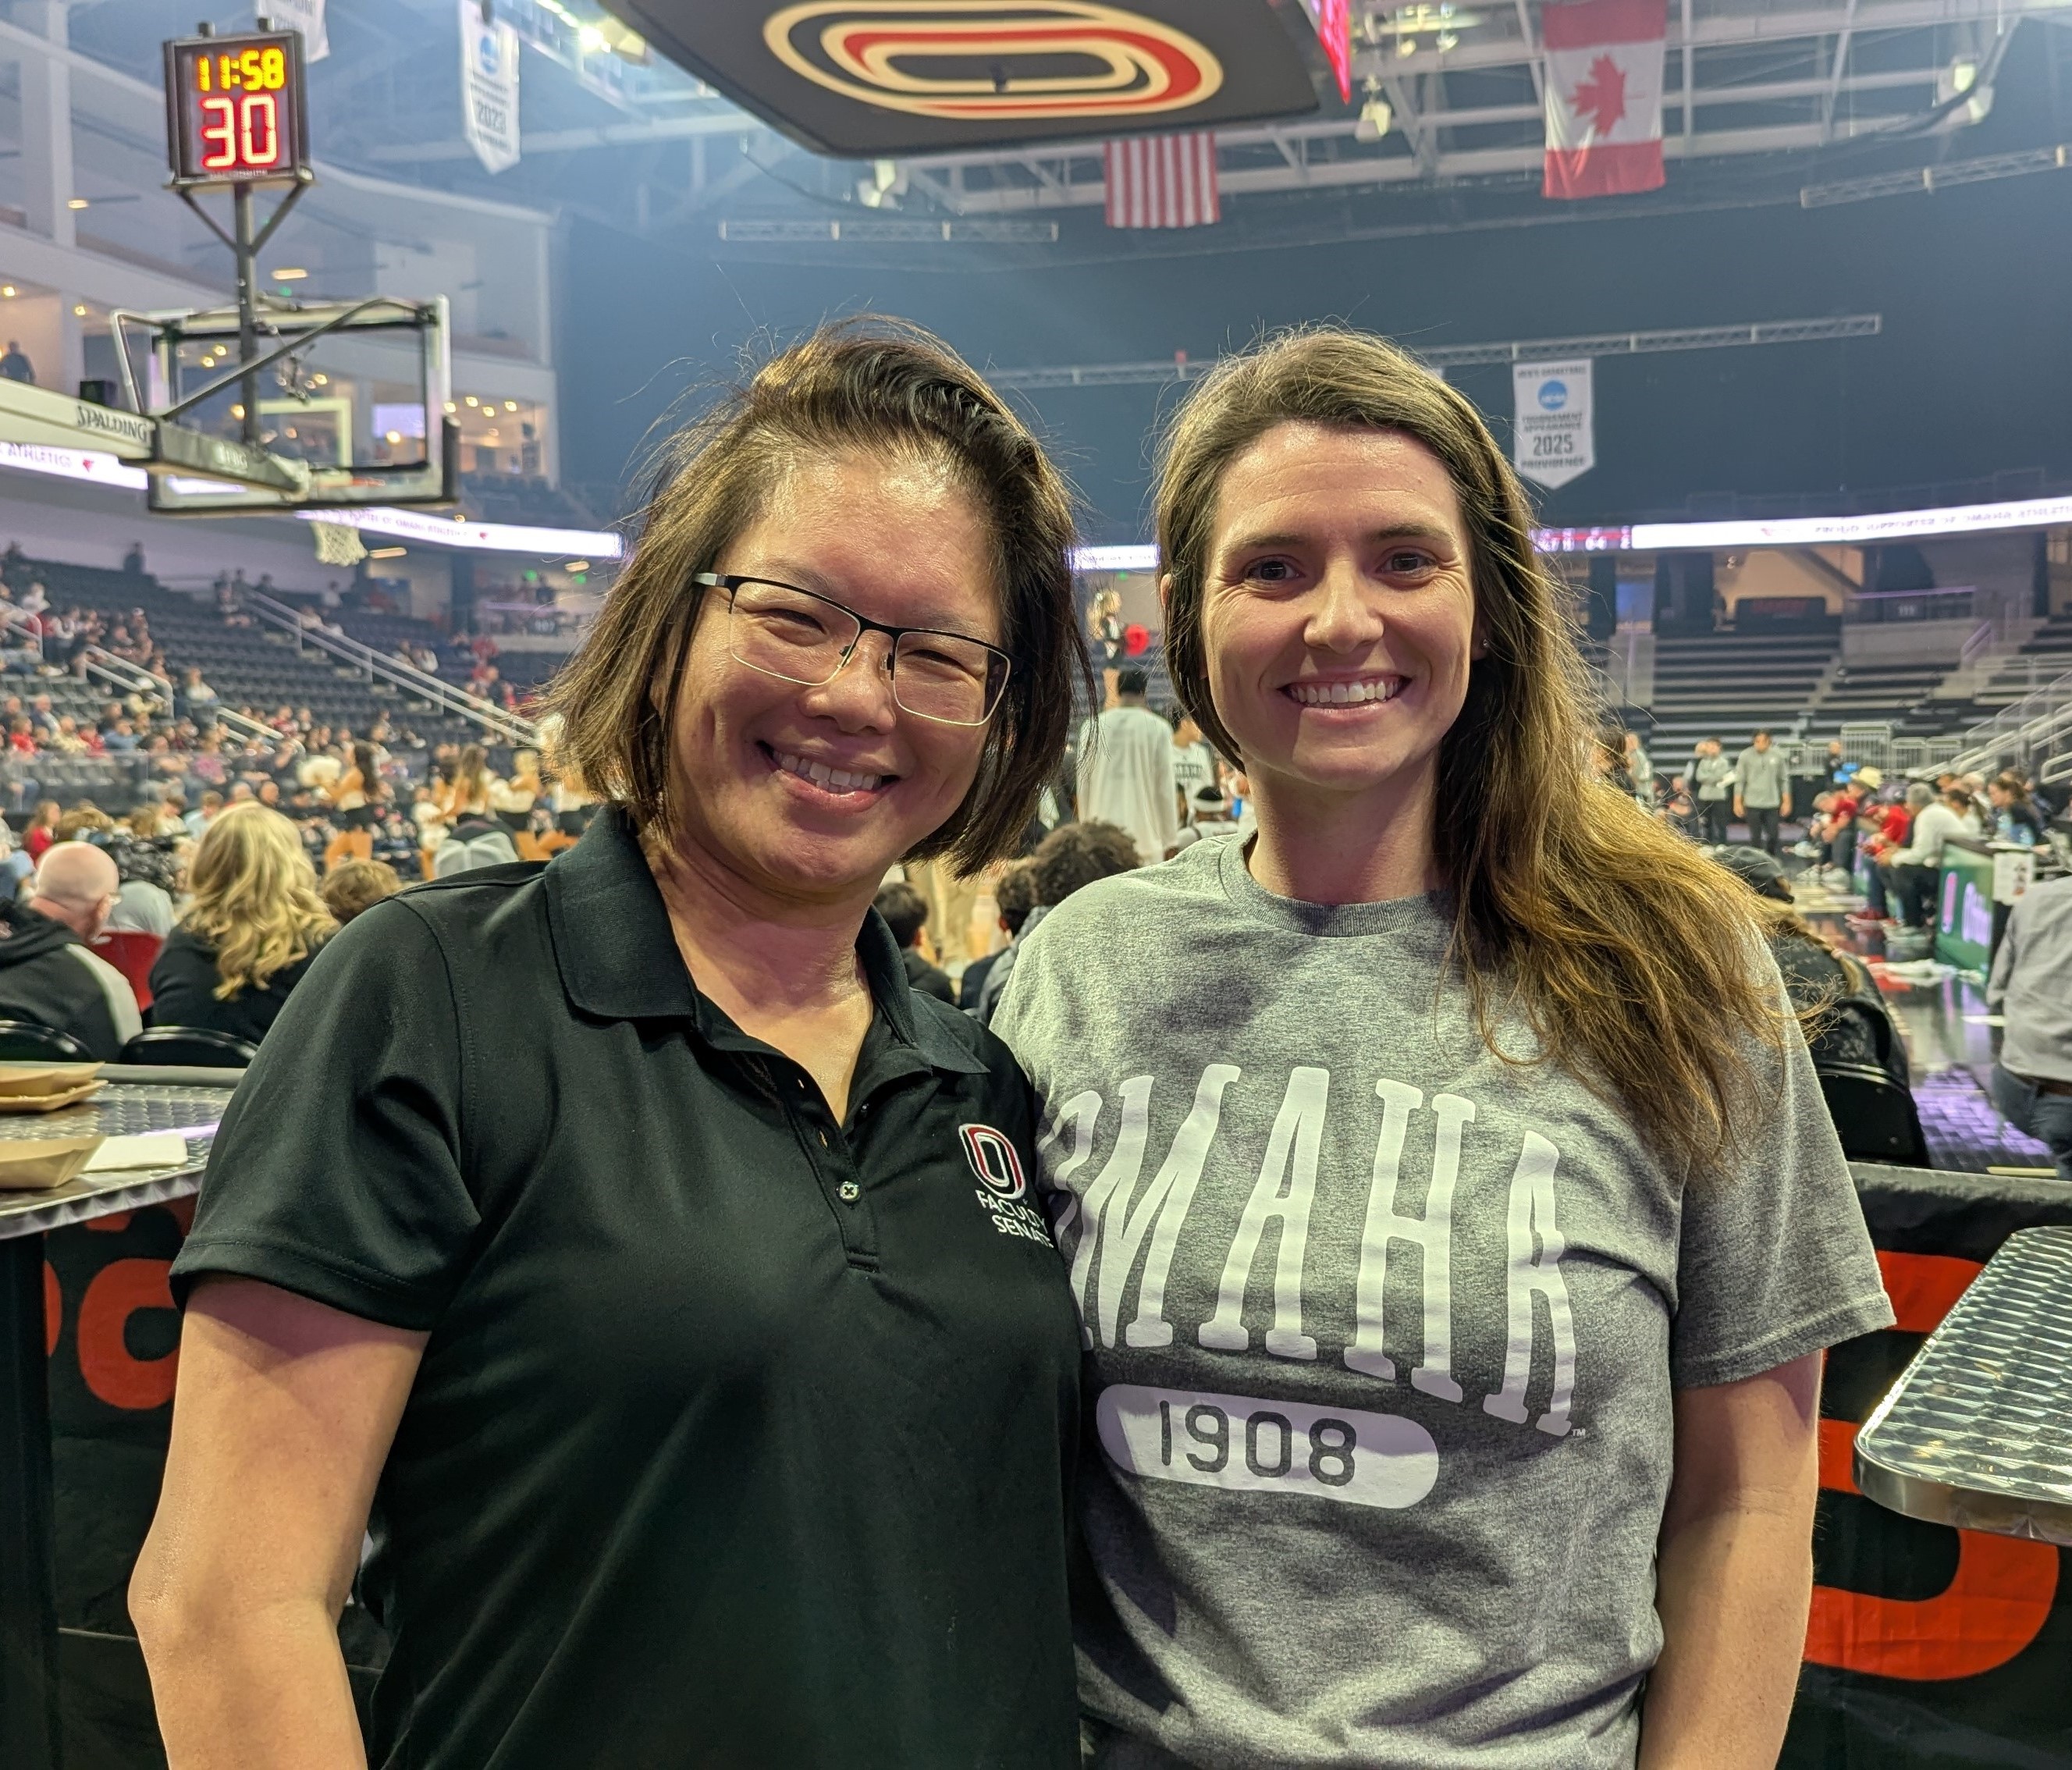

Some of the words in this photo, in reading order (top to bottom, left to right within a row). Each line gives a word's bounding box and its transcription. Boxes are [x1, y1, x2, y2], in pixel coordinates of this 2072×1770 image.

[198, 48, 285, 91] 11:58
[201, 94, 277, 167] 30
[76, 405, 149, 442] SPALDING
[1533, 434, 1573, 456] 2025
[976, 1189, 1048, 1234] FACULTY
[991, 1214, 1054, 1248] SENAT
[1159, 1400, 1357, 1487] 1908
